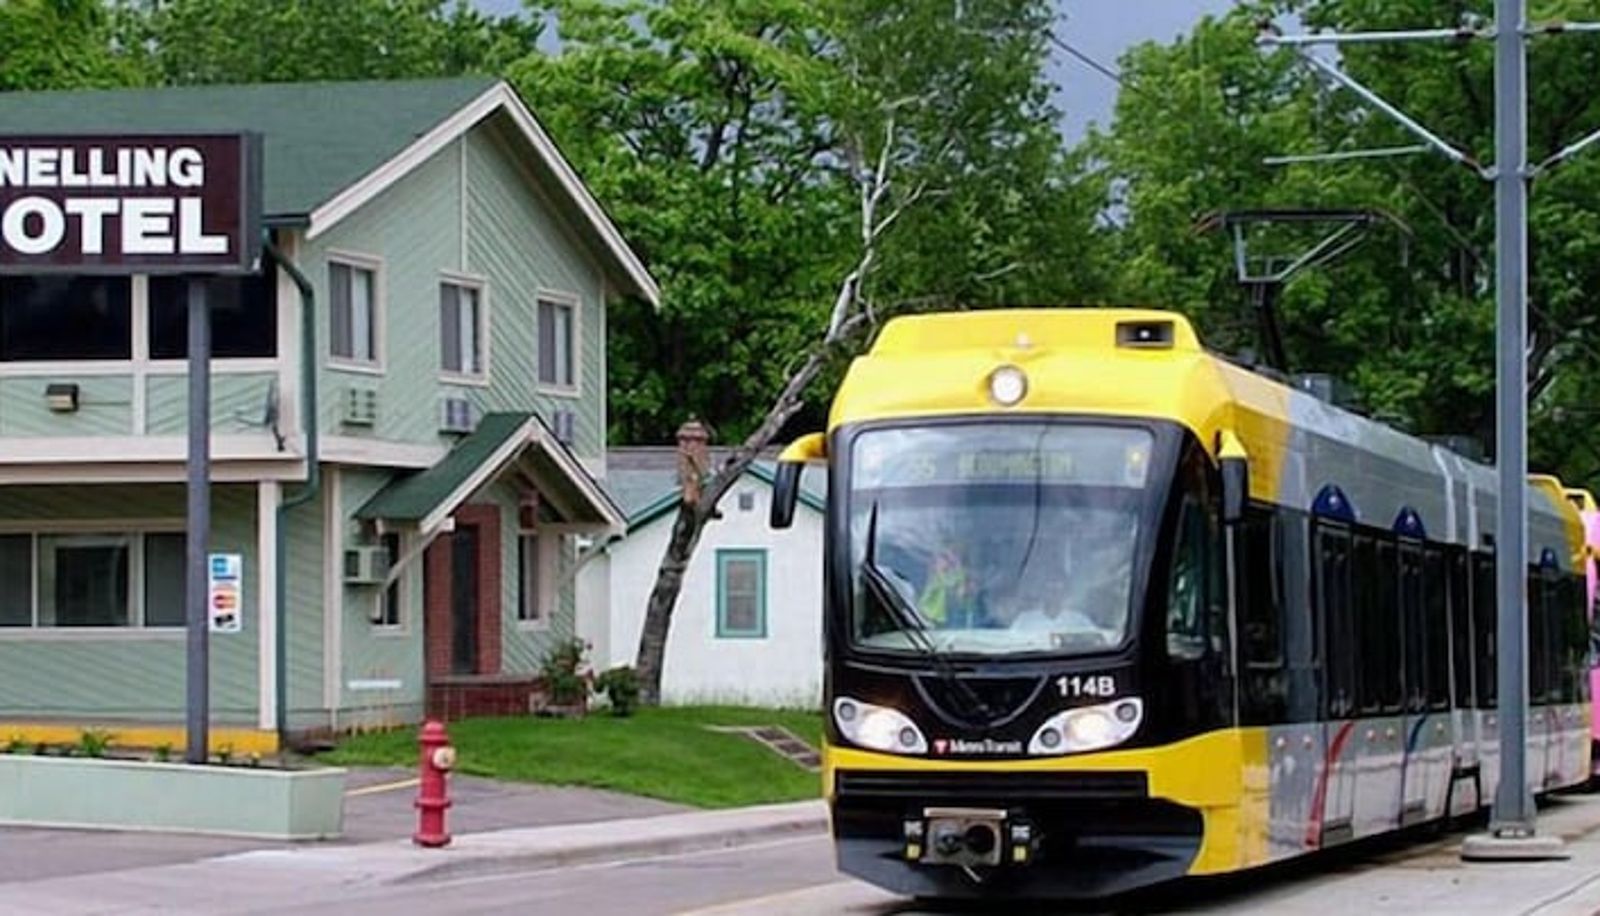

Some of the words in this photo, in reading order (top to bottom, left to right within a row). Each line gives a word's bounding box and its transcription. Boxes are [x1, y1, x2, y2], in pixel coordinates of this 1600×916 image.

[0, 148, 204, 187] NELLING
[1, 196, 229, 254] OTEL
[1055, 675, 1116, 697] 114B
